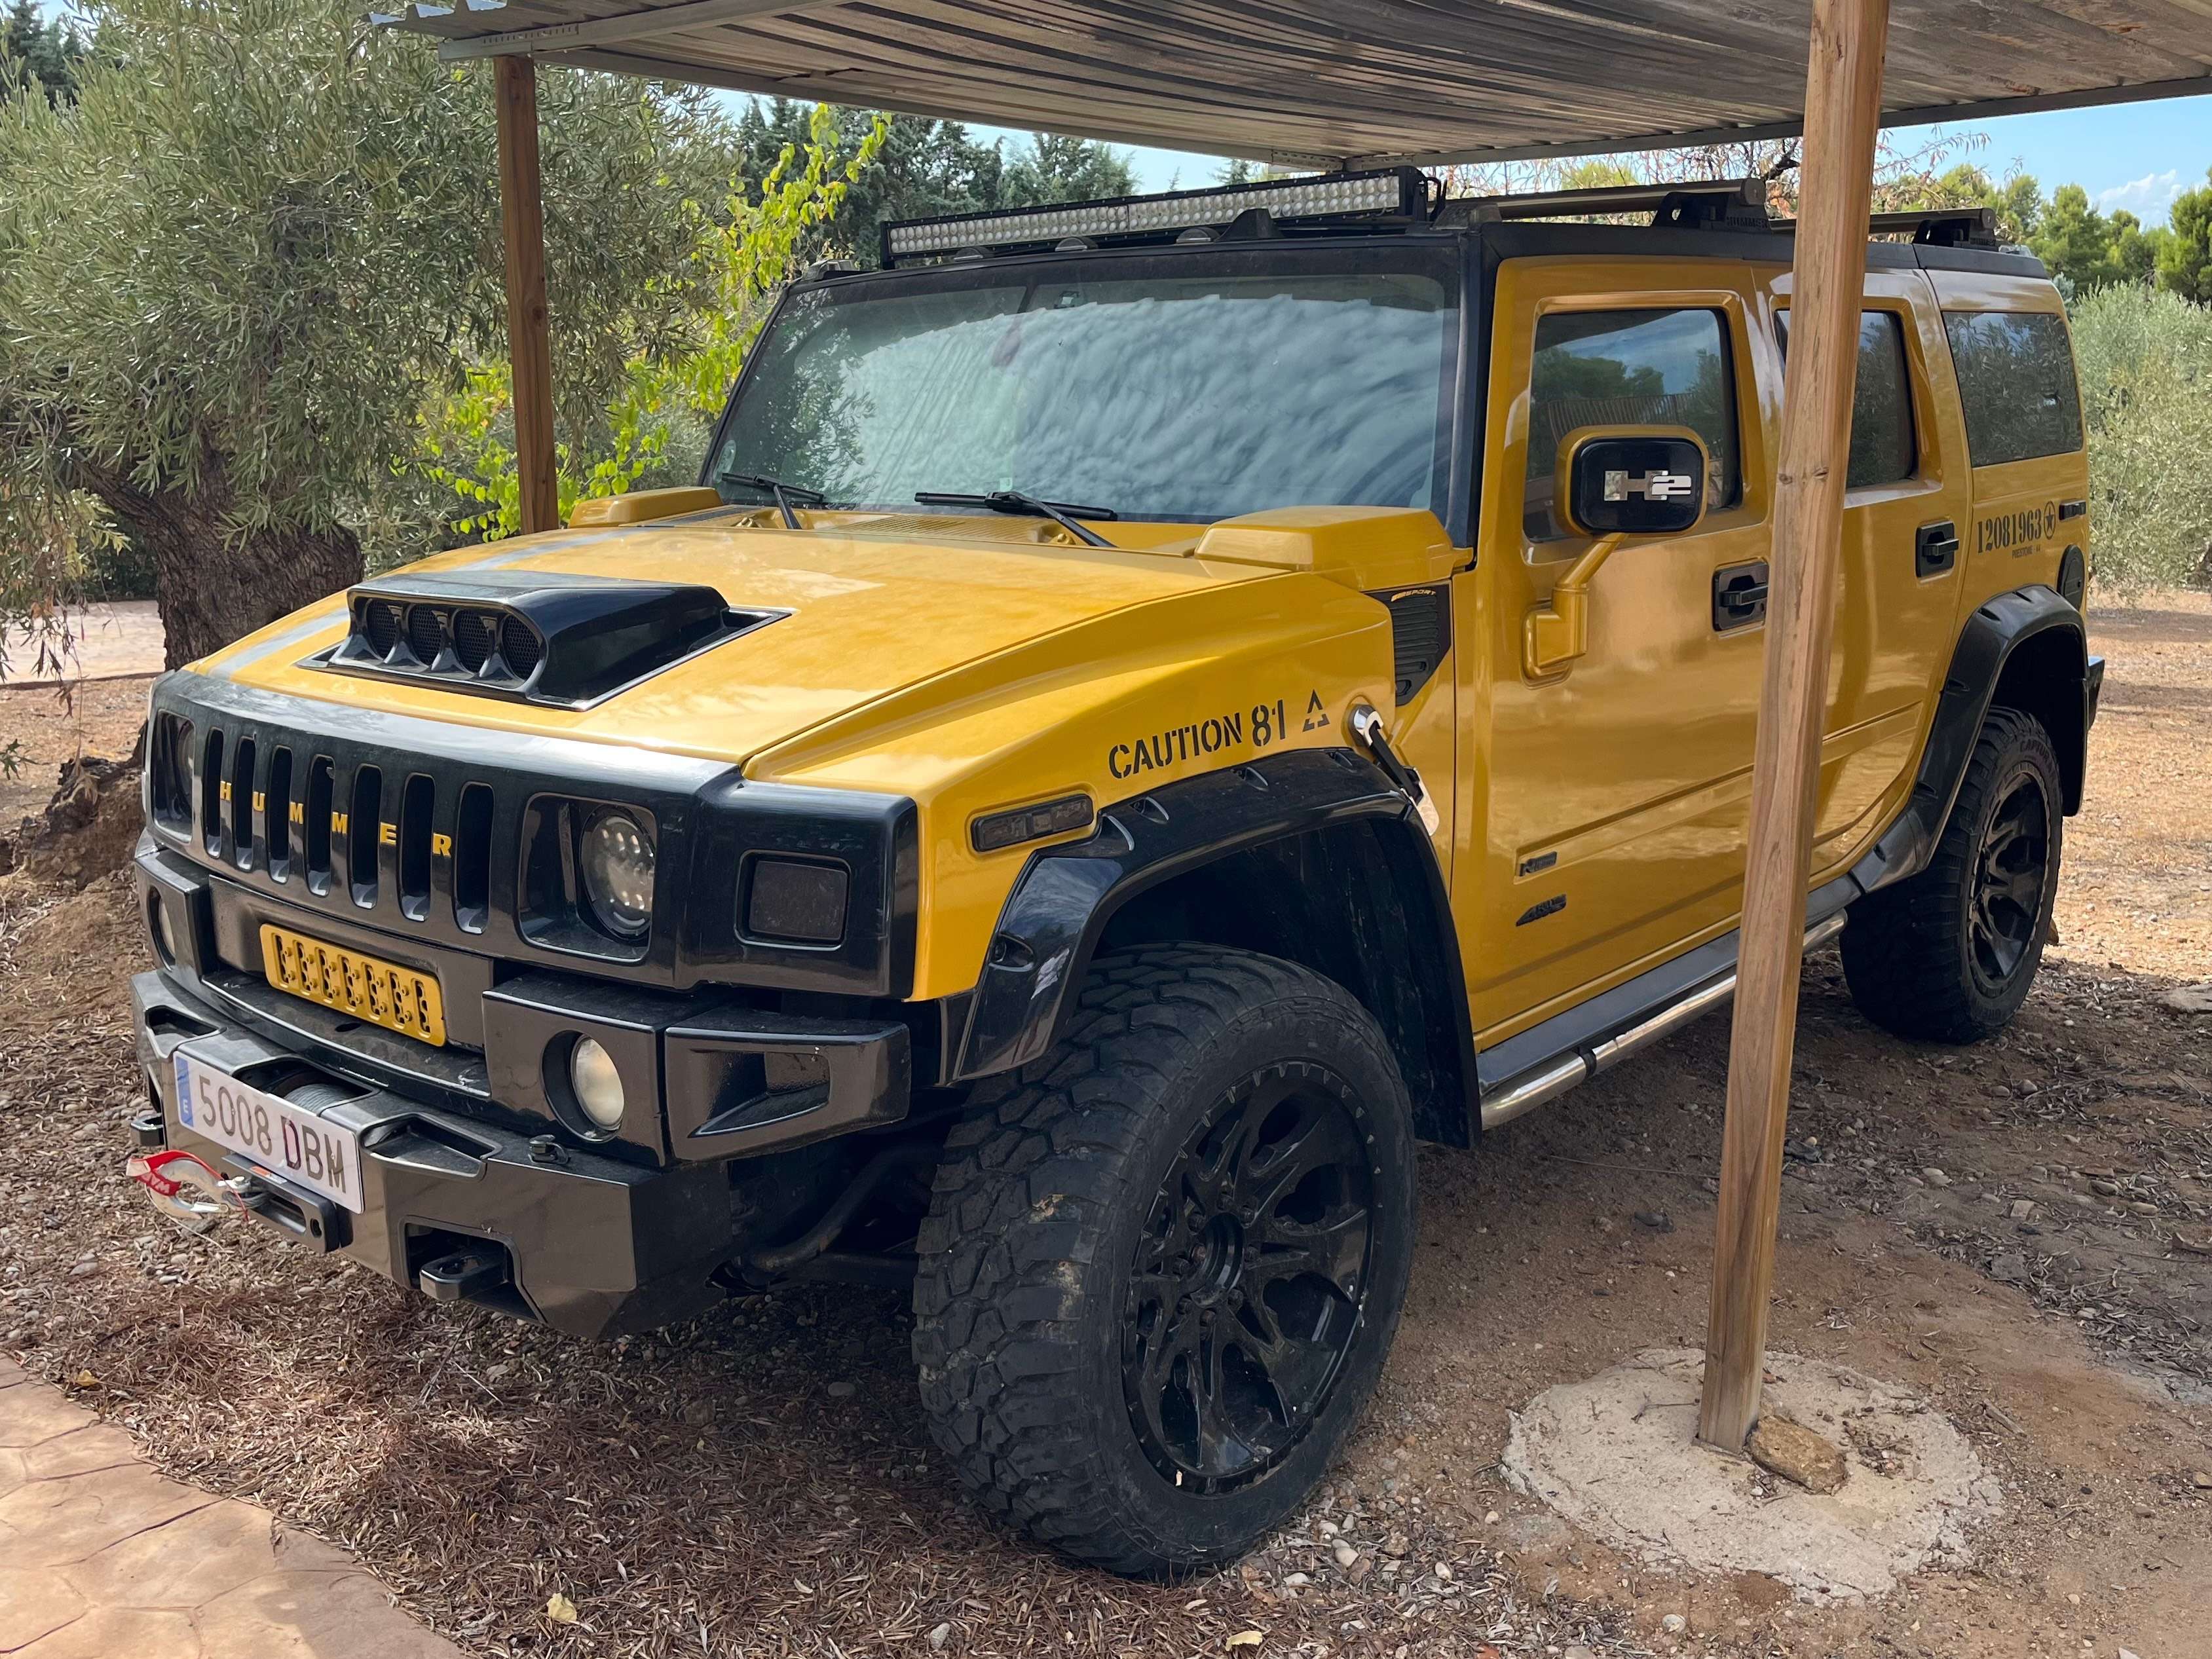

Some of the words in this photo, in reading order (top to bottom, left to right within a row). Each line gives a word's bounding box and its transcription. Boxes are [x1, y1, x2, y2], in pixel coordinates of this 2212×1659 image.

[1604, 470, 1692, 501] H2
[1977, 508, 2042, 554] 12081963
[1108, 711, 1242, 779] CAUTION
[1251, 699, 1286, 747] 81
[219, 780, 452, 858] HUMMER
[183, 1100, 189, 1115] E
[198, 1074, 273, 1156] 5008
[280, 1115, 347, 1194] DBM
